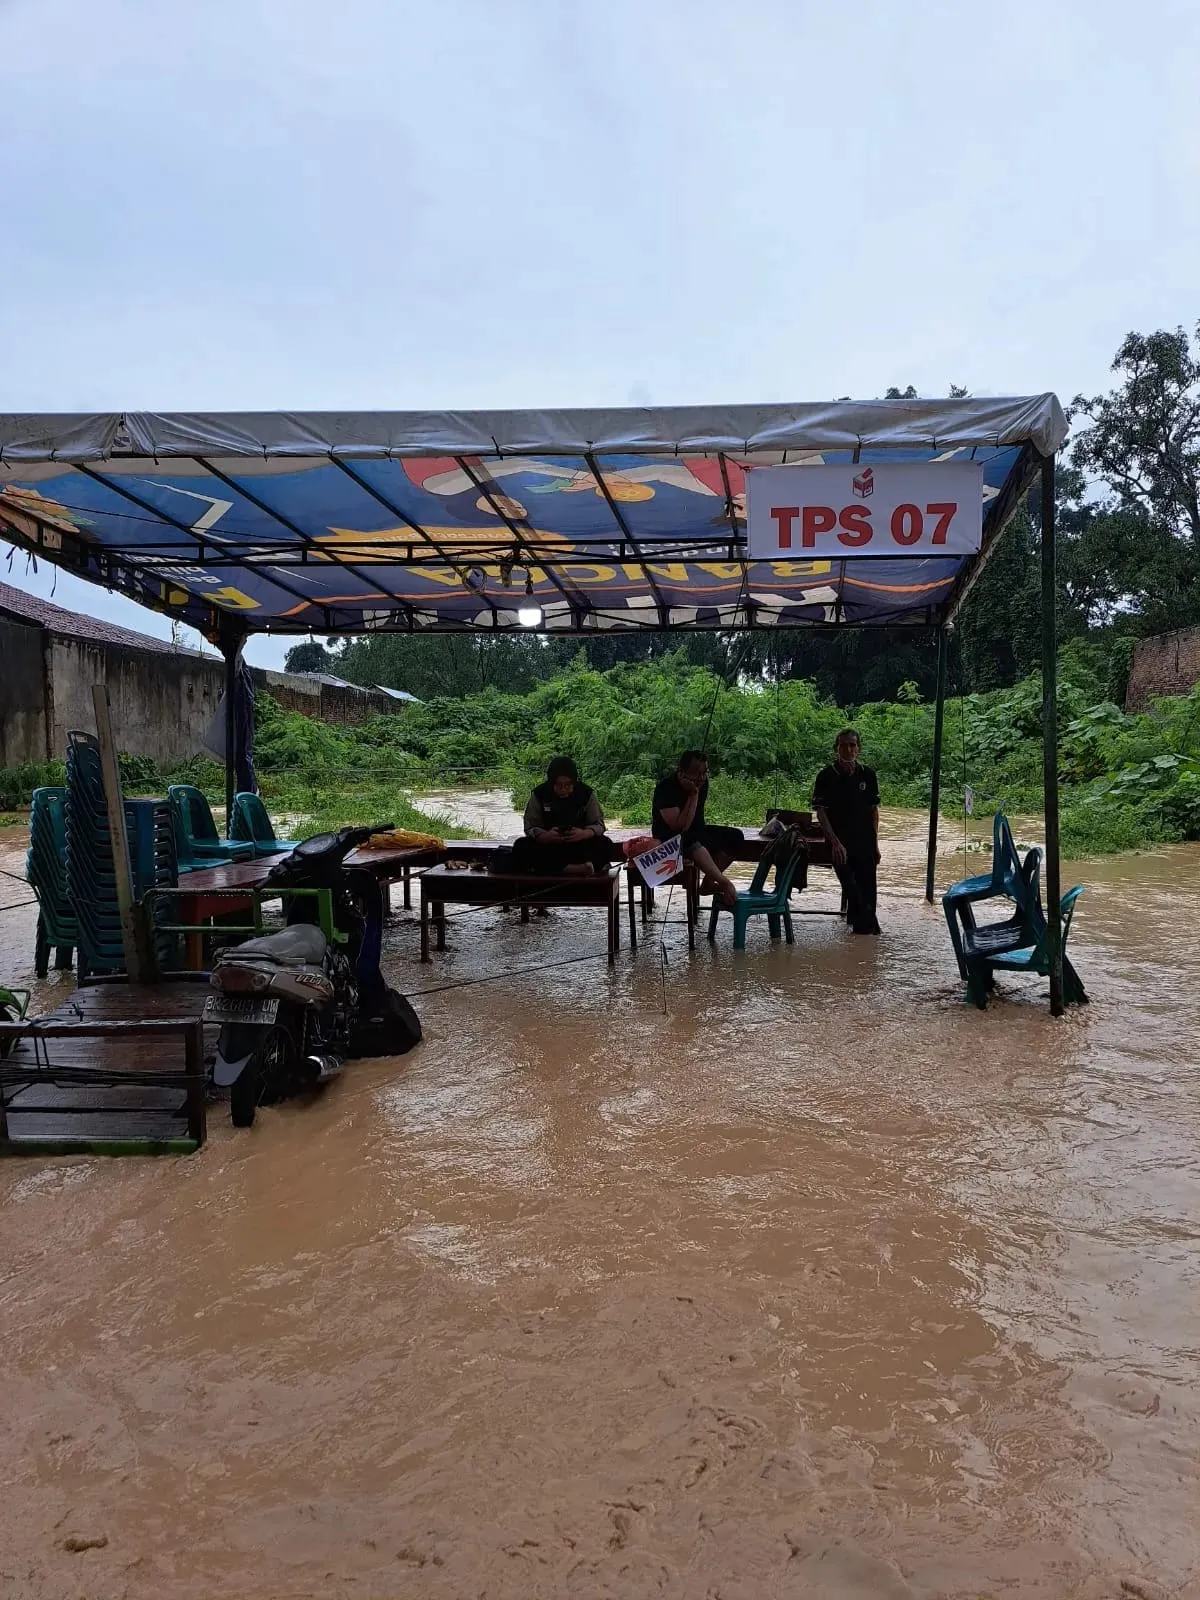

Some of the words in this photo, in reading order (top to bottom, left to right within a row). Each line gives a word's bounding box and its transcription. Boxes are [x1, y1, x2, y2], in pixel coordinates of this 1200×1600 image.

[771, 504, 874, 548] TPS
[891, 502, 957, 546] 07
[638, 838, 680, 868] MASUK
